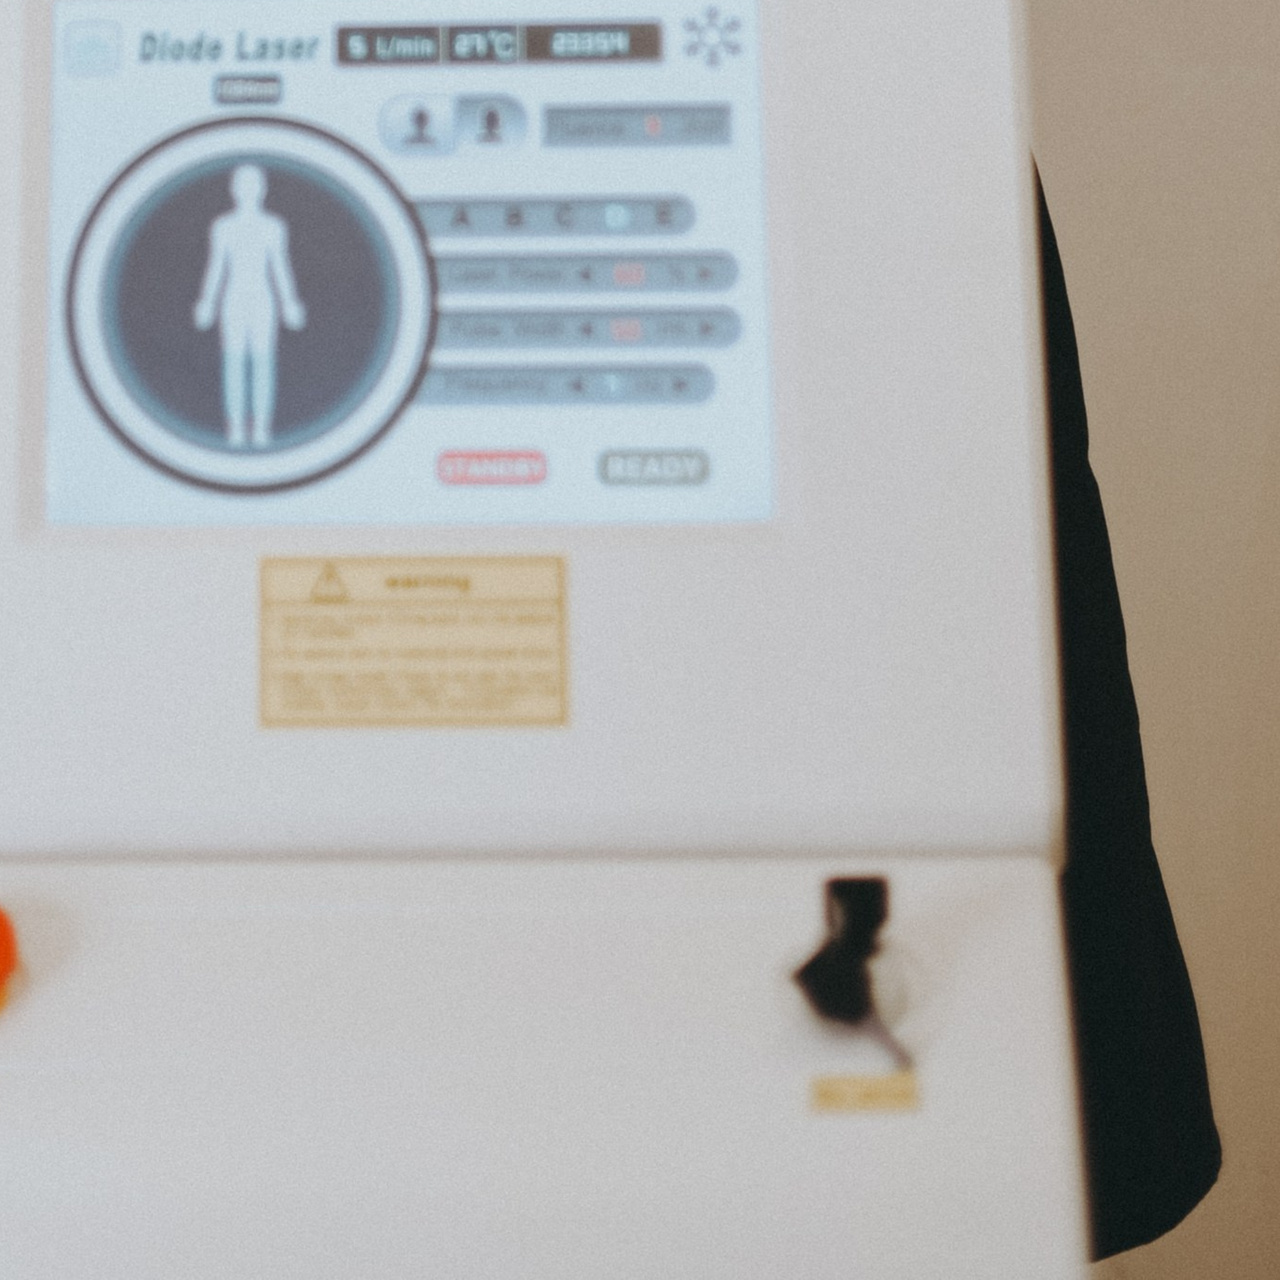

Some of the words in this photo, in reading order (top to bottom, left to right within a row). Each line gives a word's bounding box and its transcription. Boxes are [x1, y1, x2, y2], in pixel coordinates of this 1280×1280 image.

[139, 32, 223, 61] Diode
[235, 30, 318, 61] Laser
[607, 456, 702, 478] READY
